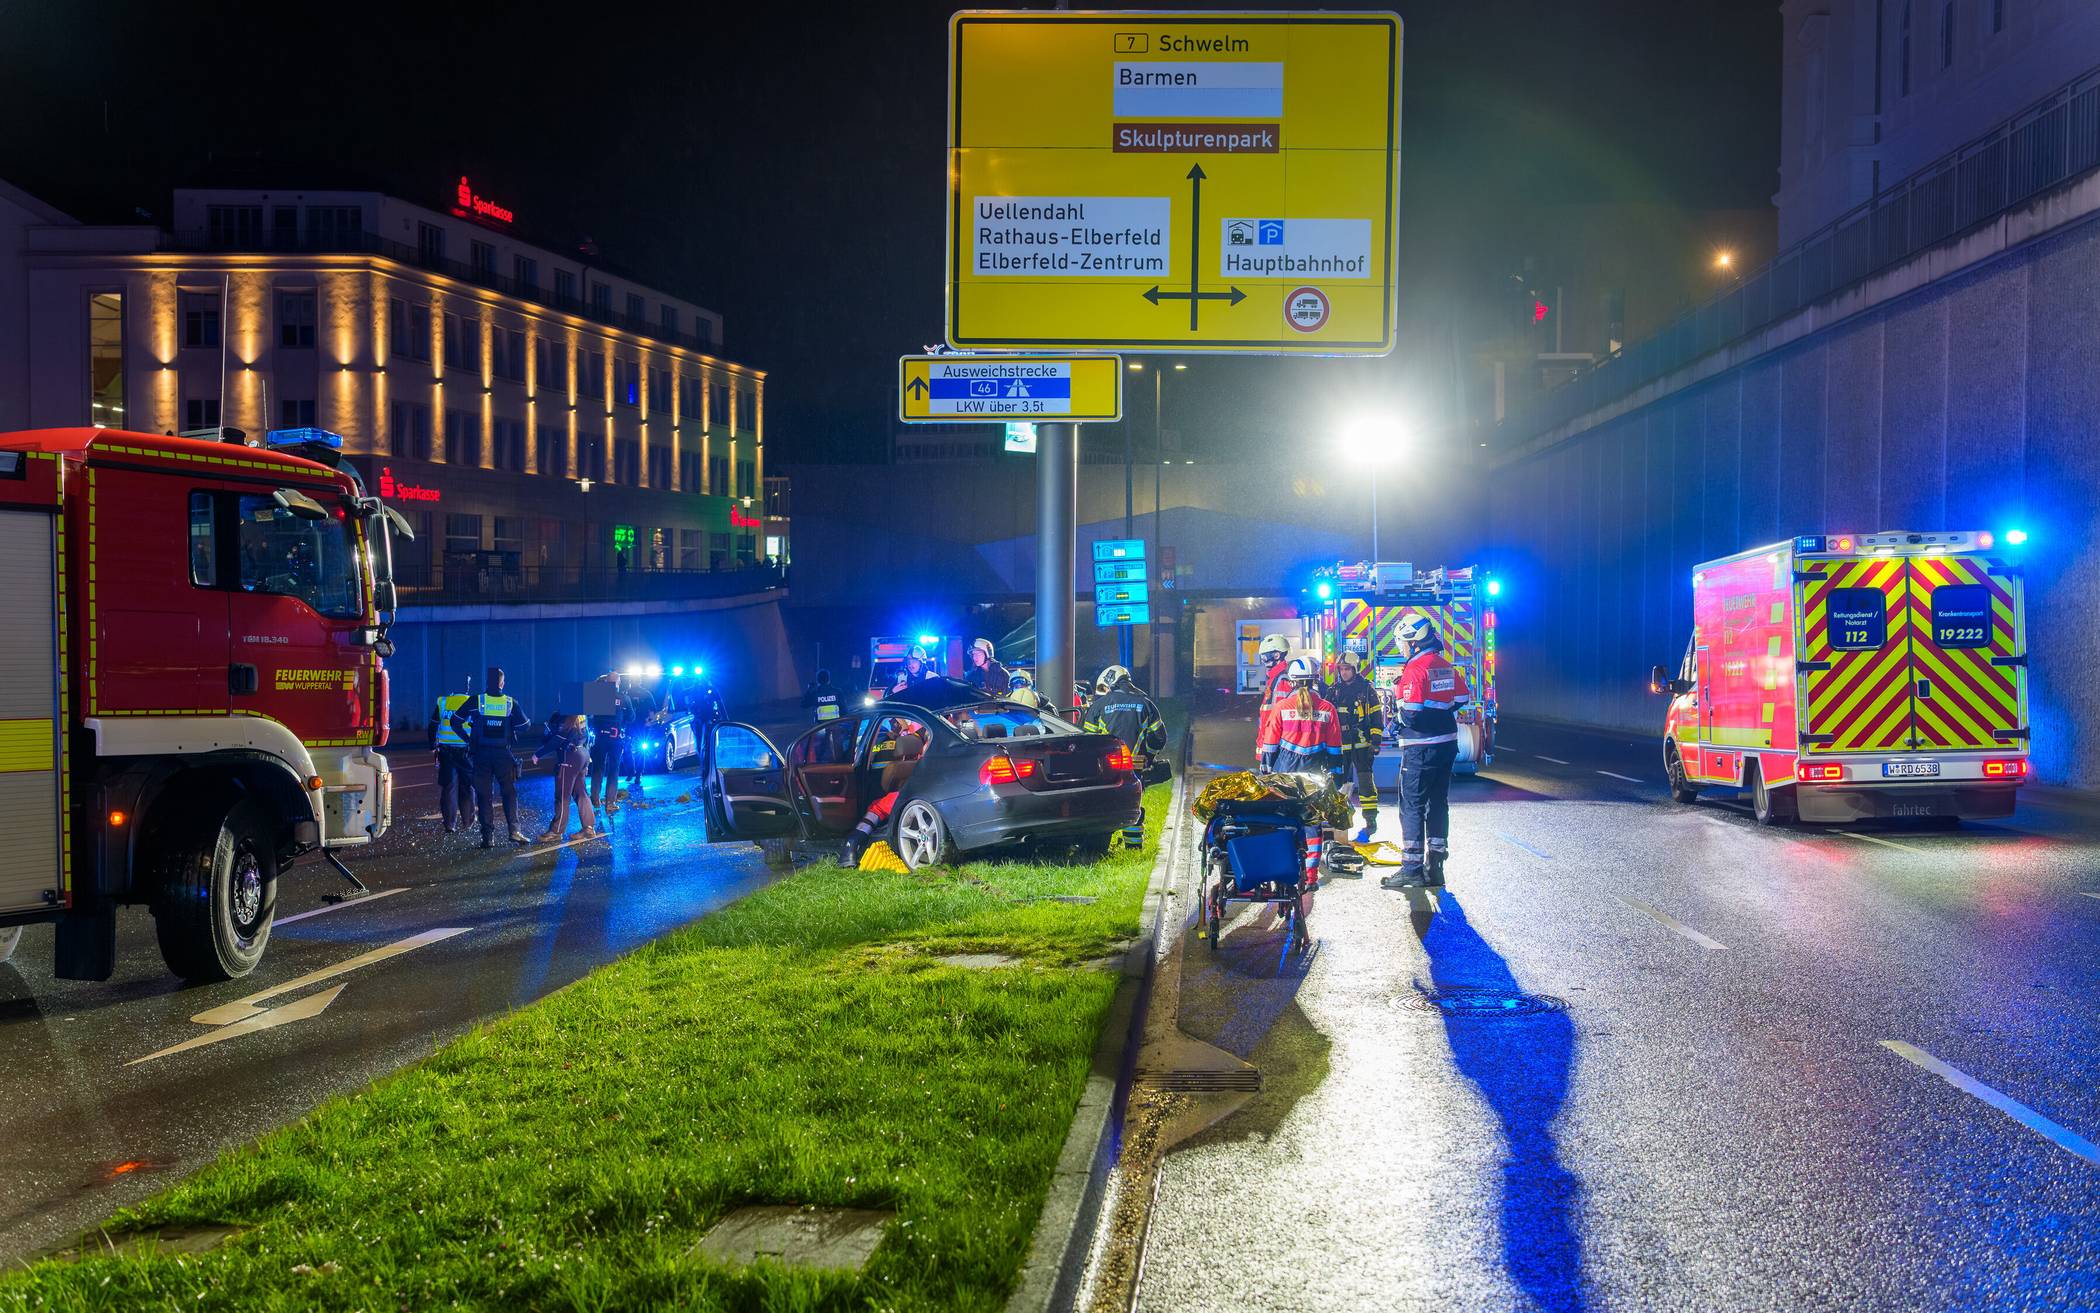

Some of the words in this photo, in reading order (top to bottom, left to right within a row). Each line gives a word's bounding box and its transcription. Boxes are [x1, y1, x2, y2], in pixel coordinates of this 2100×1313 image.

[1127, 36, 1136, 50] 7
[1159, 35, 1249, 52] Schwelm
[1119, 69, 1197, 86] Barmen
[1119, 129, 1273, 151] Skulpturenpark
[472, 195, 513, 223] Sparkasse
[980, 202, 1085, 221] Uellendahl
[980, 227, 1161, 246] Rathaus-Elberfeld
[979, 252, 1163, 270] Elberfeld-Zentrum
[1227, 253, 1365, 275] Hauptbahnhof
[943, 365, 1057, 378] Ausweichstrecke
[978, 384, 991, 394] 46
[956, 401, 985, 413] LKW
[989, 400, 1018, 413] über
[1021, 400, 1044, 414] 3,5t
[397, 483, 440, 502] Sparkasse
[1833, 611, 1873, 620] Rettungsdienst
[1938, 610, 1984, 618] Krankentransport
[1845, 631, 1868, 643] 112
[275, 669, 342, 681] FEUERWEHR
[294, 682, 333, 690] WUPPERTAL
[817, 695, 837, 703] POLIZEI
[1888, 766, 1896, 774] W
[1901, 764, 1914, 774] RD
[1915, 763, 1938, 774] 6538
[1892, 803, 1932, 816] fahrtec
